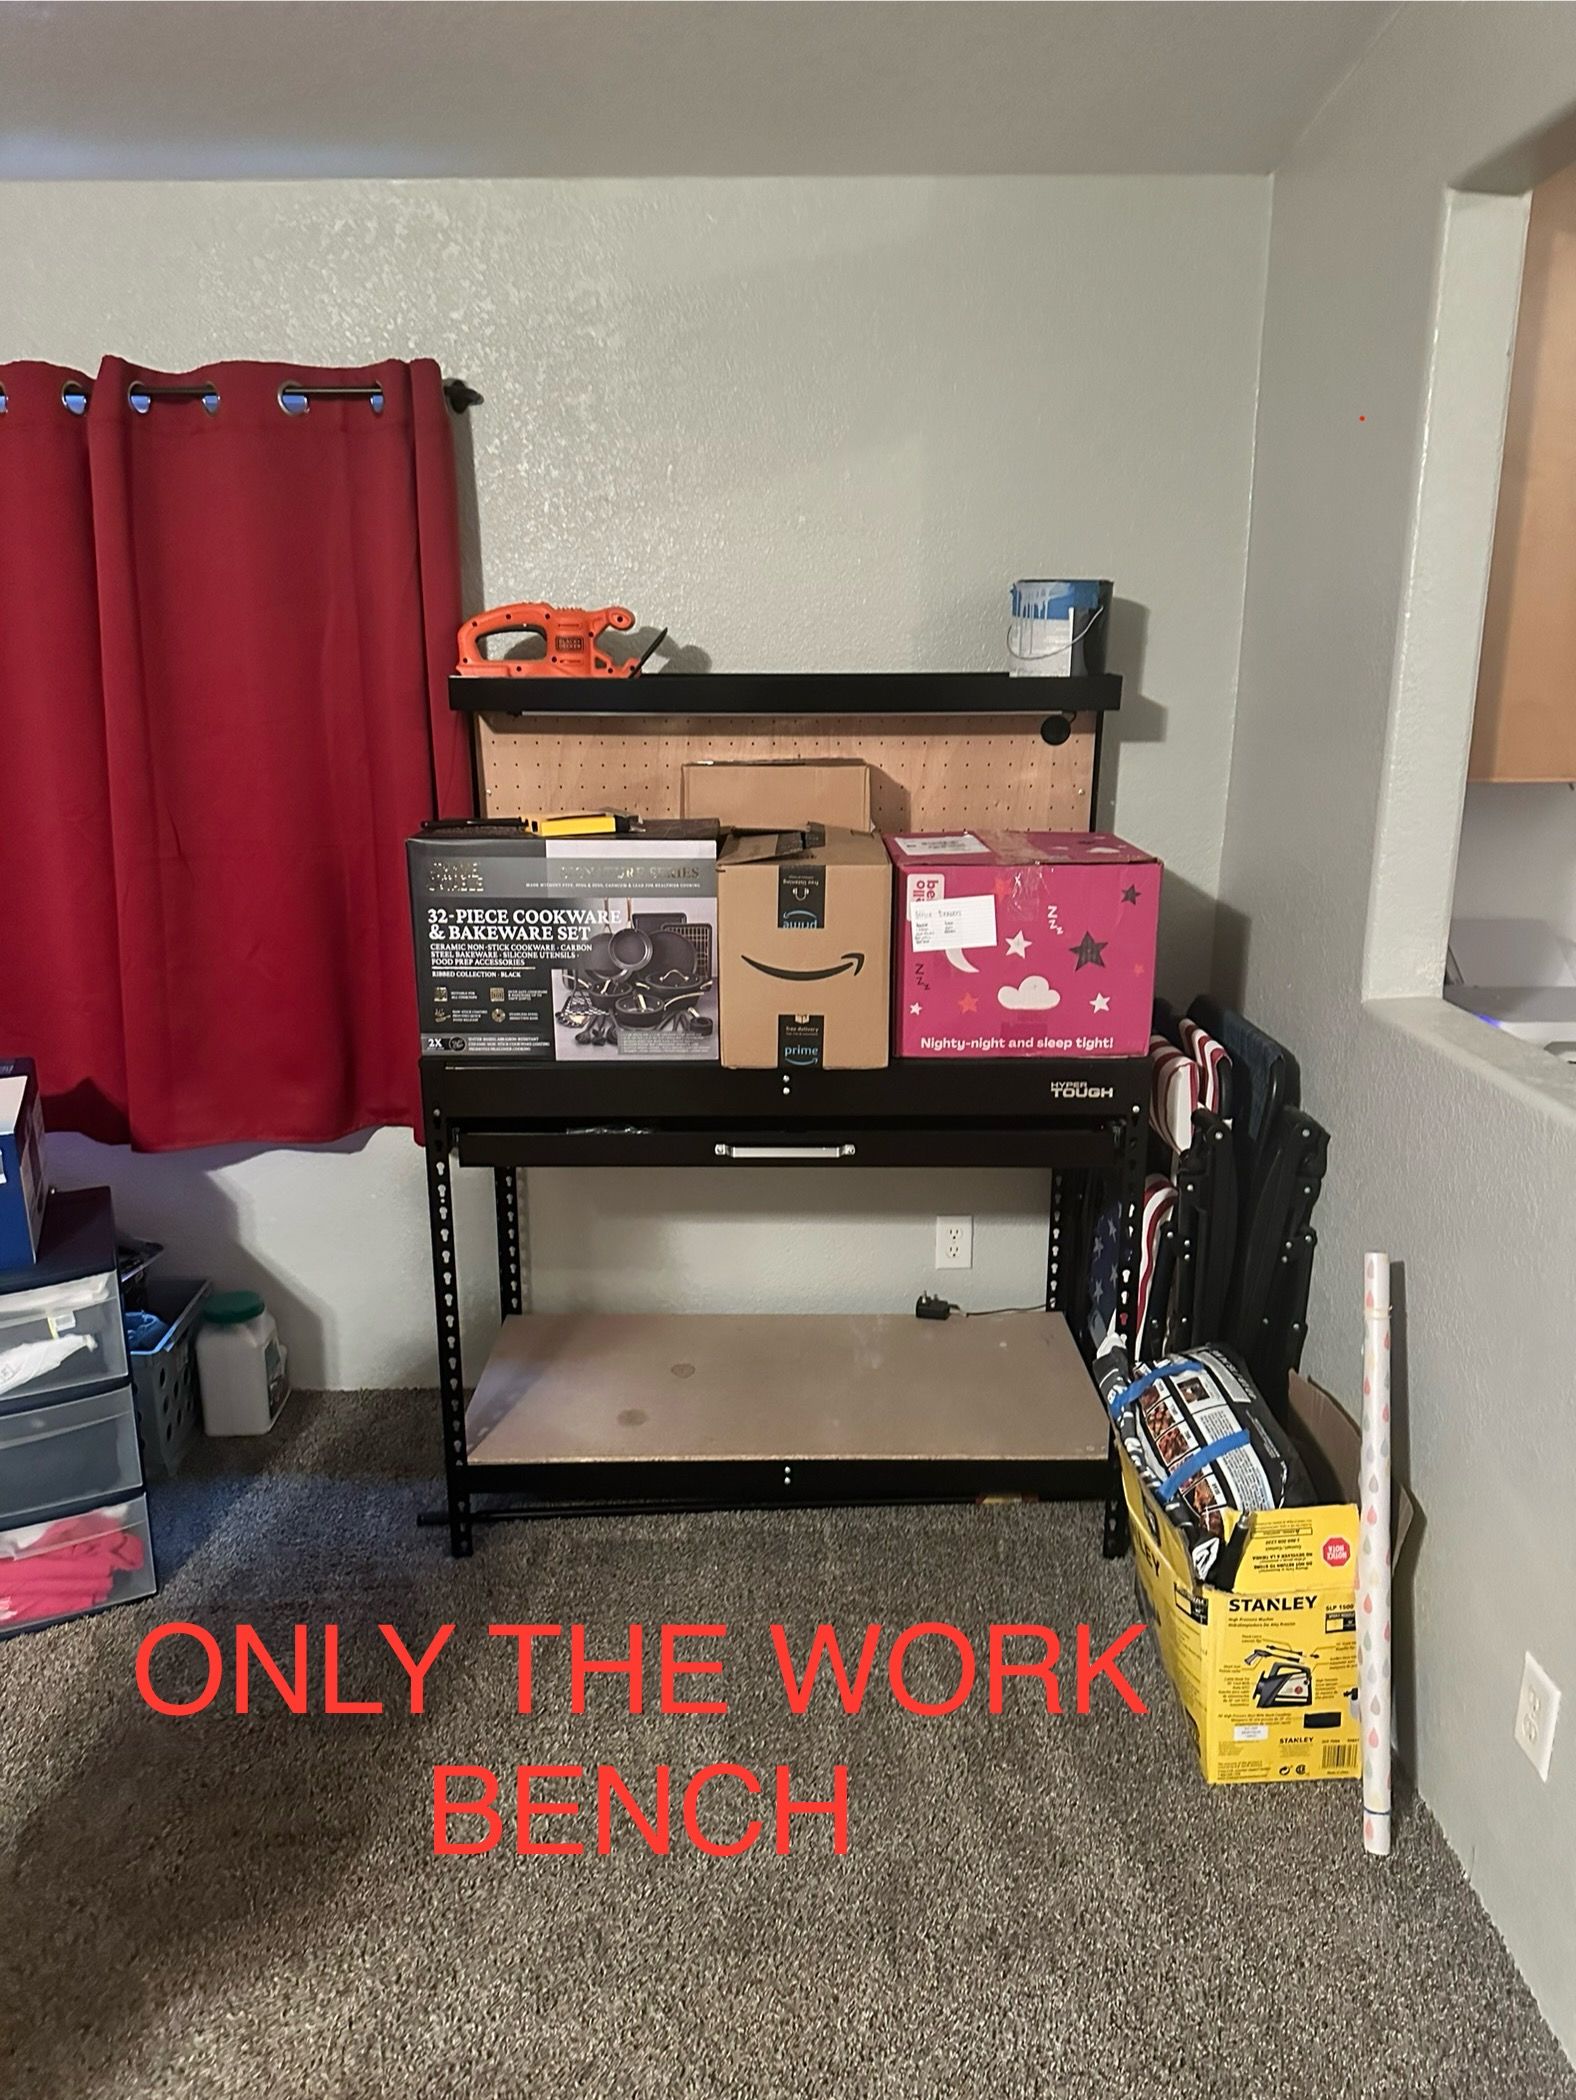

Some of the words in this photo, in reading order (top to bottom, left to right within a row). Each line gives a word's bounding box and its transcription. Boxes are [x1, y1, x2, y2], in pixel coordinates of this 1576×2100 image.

[427, 908, 509, 924] 32-PIECE
[512, 909, 622, 925] COOKWARE
[428, 925, 446, 940] &
[449, 926, 554, 940] BAKEWARE
[557, 926, 591, 940] SET
[560, 944, 592, 952] CARBON
[503, 951, 538, 959] SILICONE
[428, 1038, 442, 1048] 2X
[920, 1037, 1006, 1051] Nighty-night
[1008, 1037, 1034, 1049] and
[1036, 1038, 1072, 1050] sleep
[1076, 1037, 1114, 1050] tight!
[784, 1044, 818, 1057] prime
[1050, 1087, 1114, 1098] TOUGH
[1228, 1596, 1318, 1612] STANLEY
